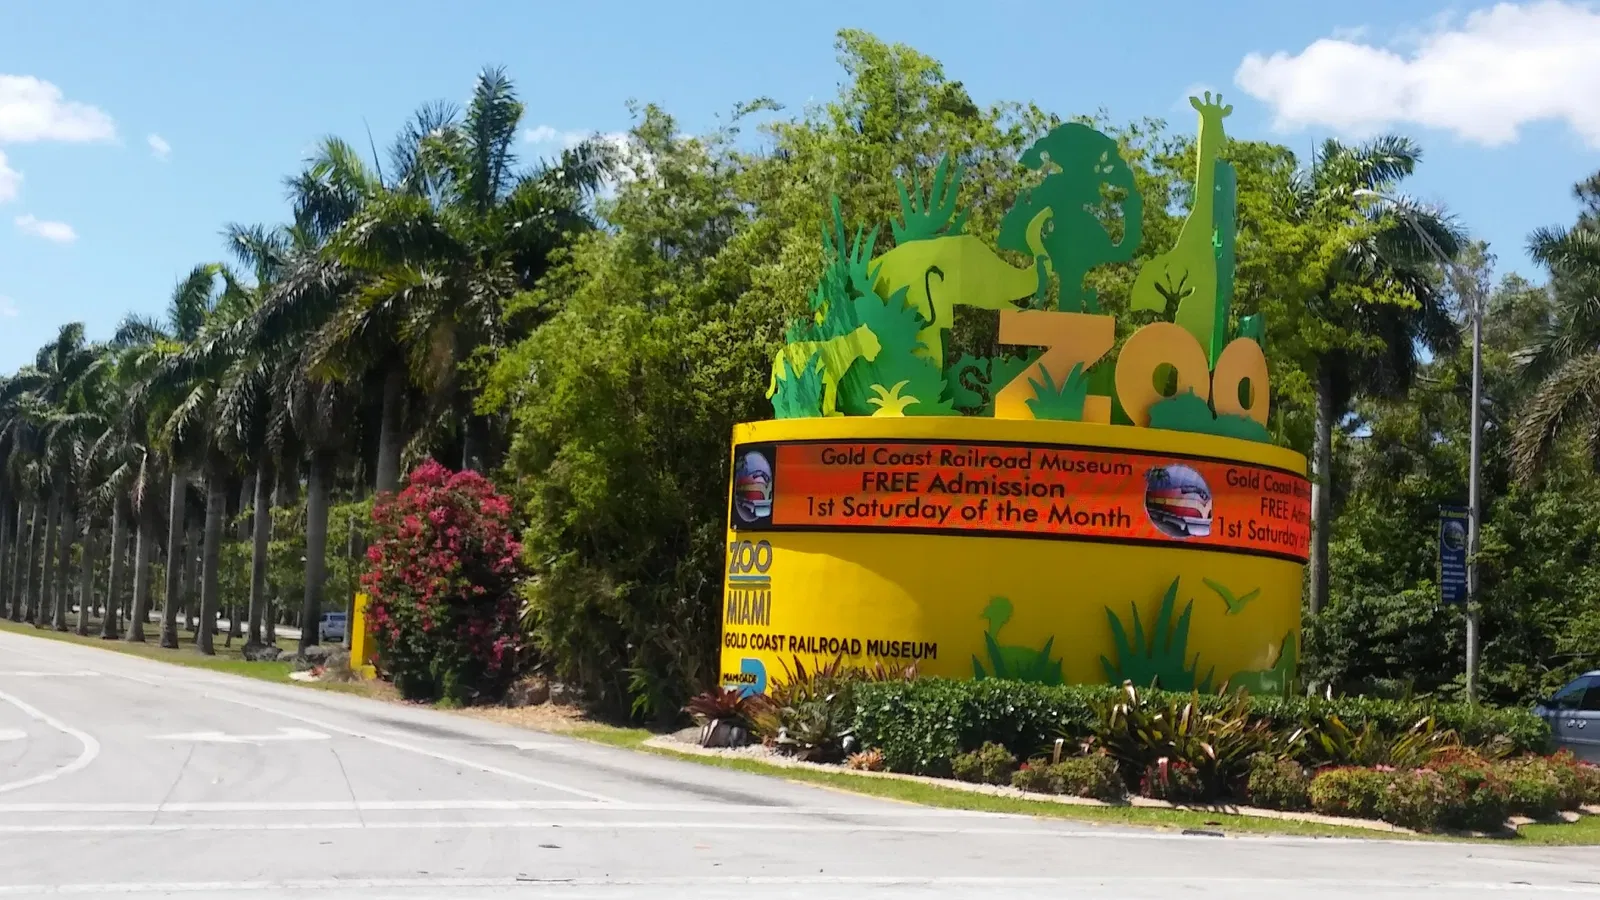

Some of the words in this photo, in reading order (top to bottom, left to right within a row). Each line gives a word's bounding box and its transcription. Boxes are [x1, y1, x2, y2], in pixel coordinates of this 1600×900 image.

[994, 309, 1270, 428] ZOO
[821, 447, 865, 466] Gold
[873, 449, 932, 467] Coast
[940, 449, 1032, 470] Railroad
[1040, 454, 1133, 476] Museum
[862, 472, 920, 492] FREE
[927, 472, 1065, 499] Admission
[1226, 468, 1260, 490] Gold
[806, 496, 835, 517] 1st
[843, 497, 951, 524] Saturday
[961, 498, 988, 521] of
[996, 500, 1038, 524] the
[1048, 503, 1132, 529] Month
[1260, 496, 1289, 521] FREE
[1217, 515, 1243, 538] 1st
[1247, 519, 1299, 551] Saturday
[728, 539, 773, 574] ZOO
[725, 590, 772, 627] MIAMI
[724, 632, 748, 650] GOLD
[750, 633, 786, 653] COAST
[788, 635, 862, 656] RAILROAD
[866, 638, 938, 660] MUSEUM
